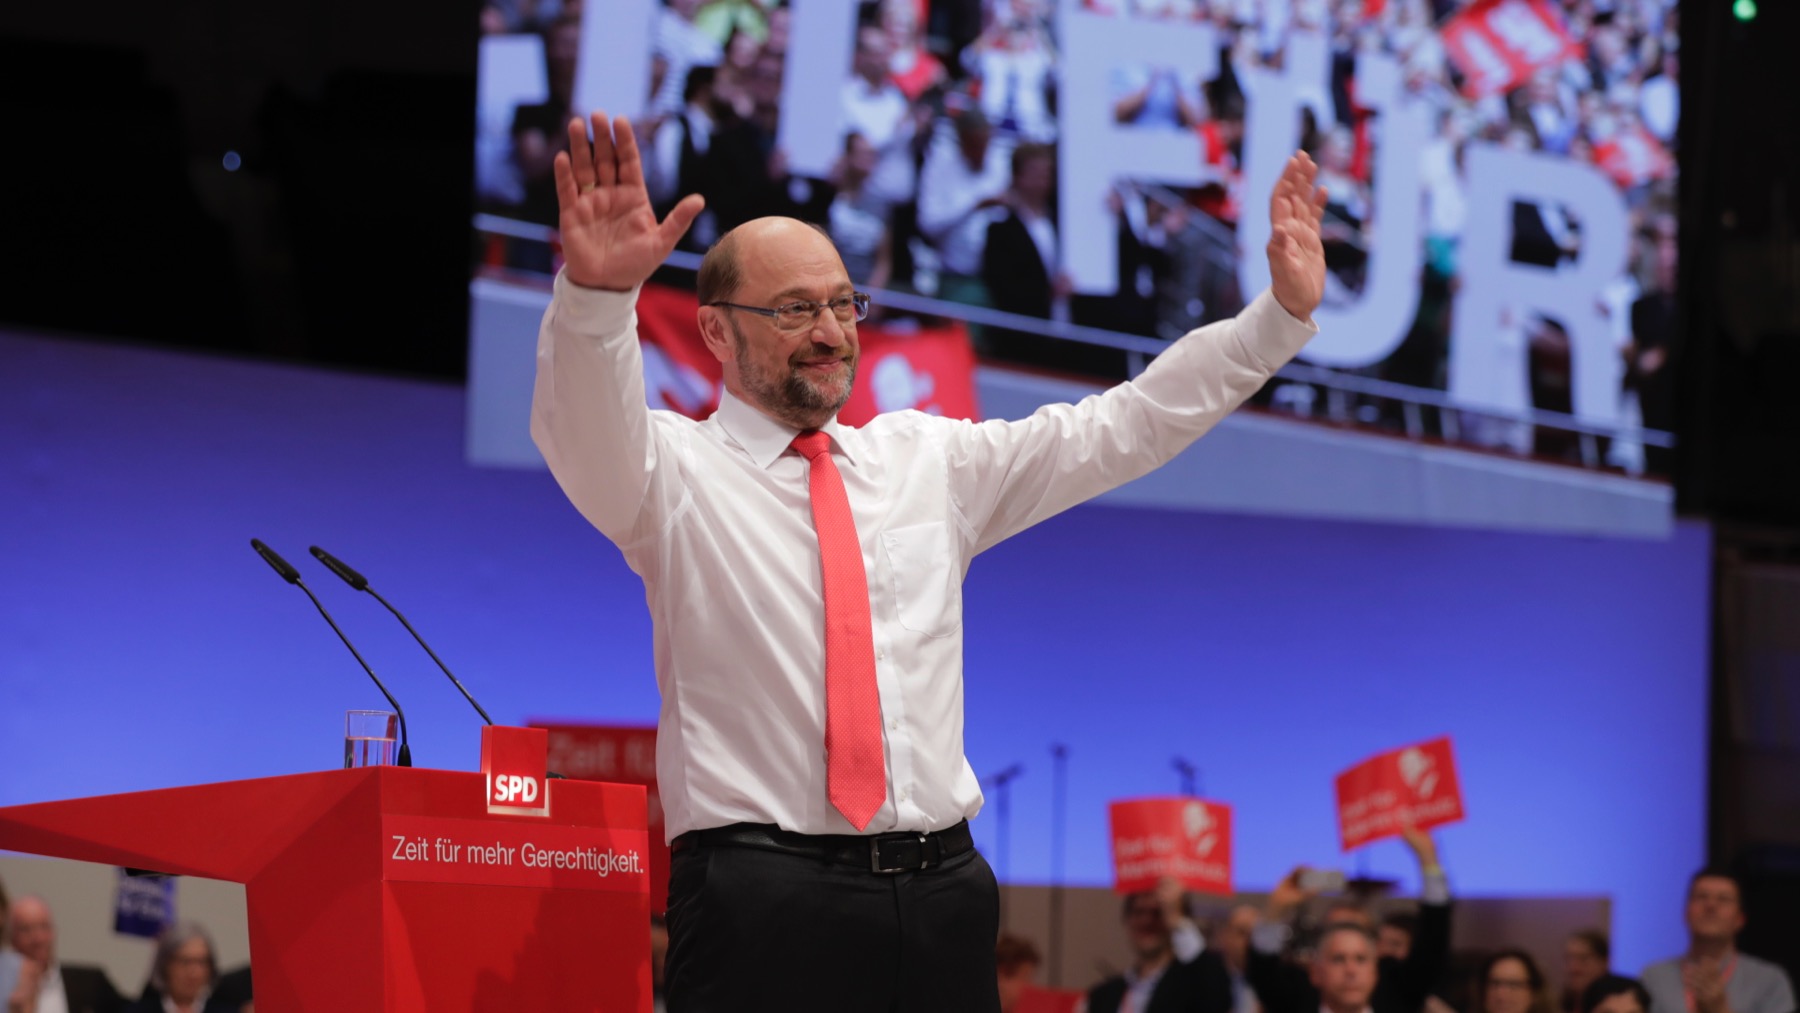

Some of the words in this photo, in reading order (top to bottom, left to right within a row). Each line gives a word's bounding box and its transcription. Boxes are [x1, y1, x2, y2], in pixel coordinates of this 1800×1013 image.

[1056, 8, 1630, 424] FÜR
[494, 774, 538, 803] SPD
[392, 835, 429, 862] Zeit
[434, 838, 461, 863] für
[467, 841, 515, 866] mehr
[521, 843, 644, 877] Gerechtigkeit.
